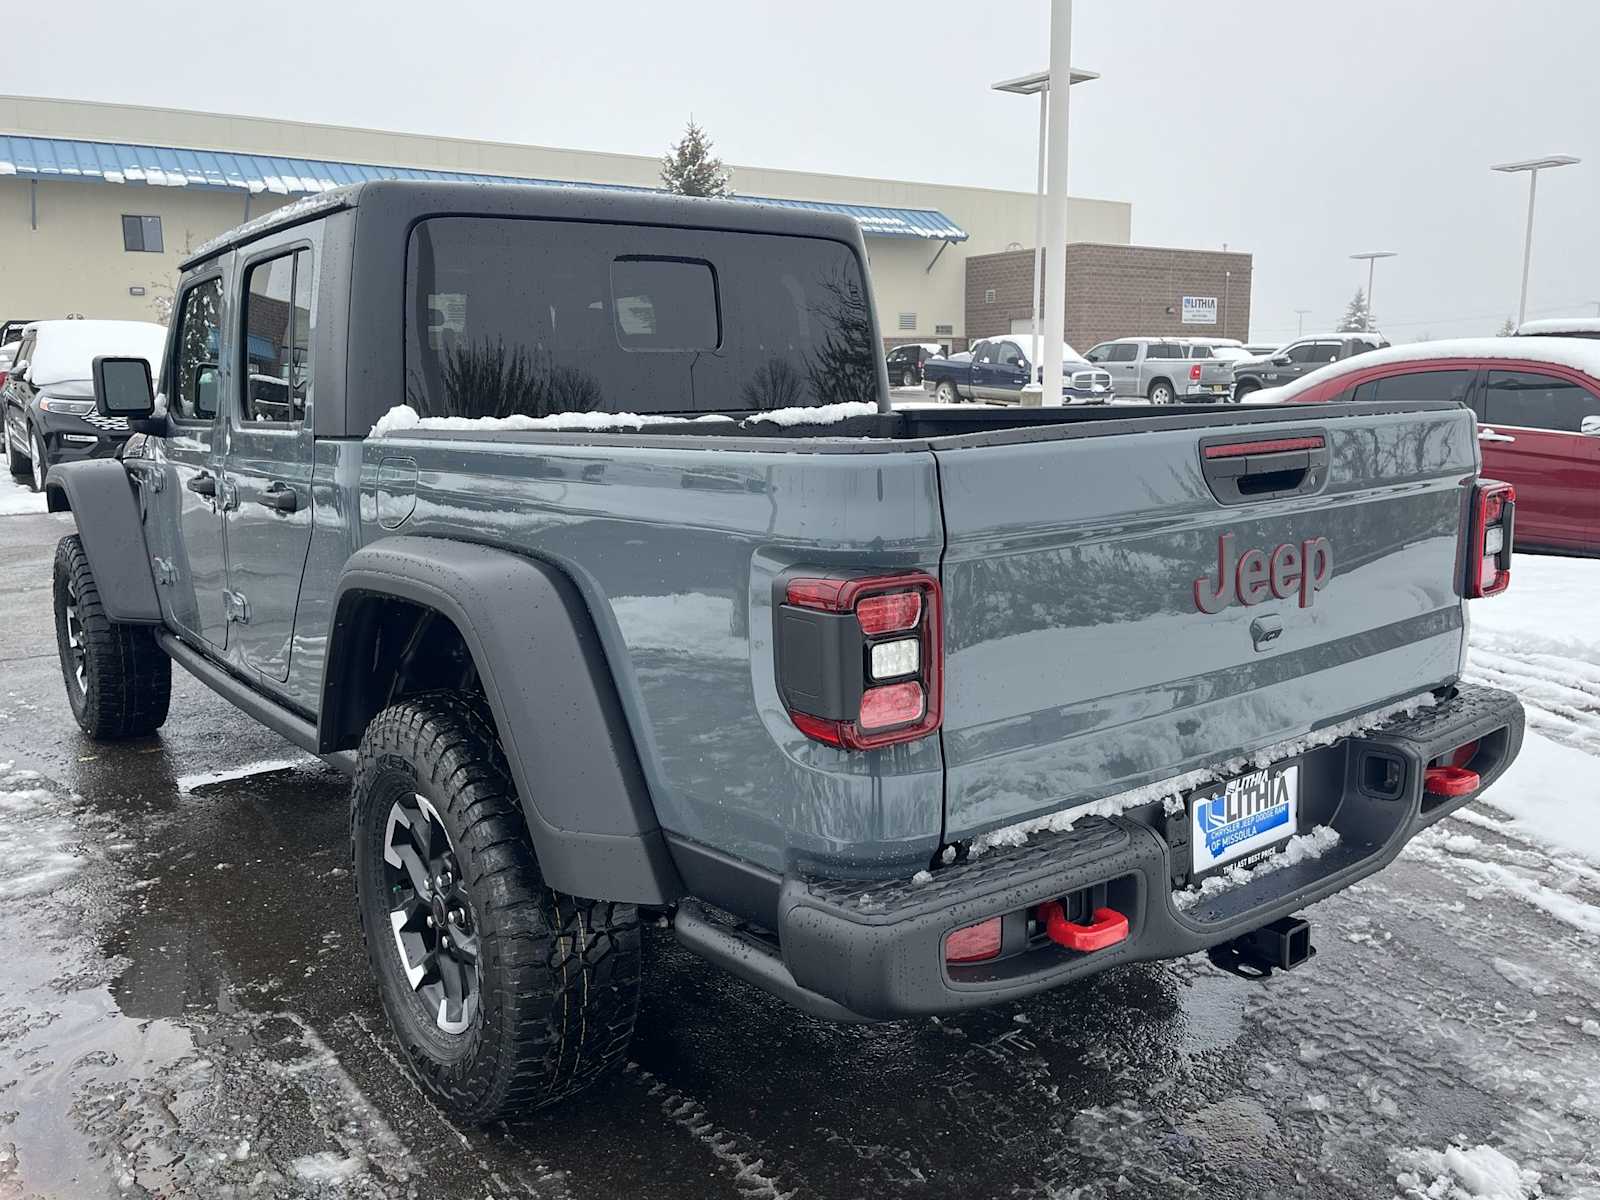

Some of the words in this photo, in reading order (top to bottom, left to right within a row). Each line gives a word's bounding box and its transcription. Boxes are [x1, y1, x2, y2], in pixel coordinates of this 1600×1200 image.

[1191, 298, 1215, 309] LITHIA
[1194, 531, 1334, 614] Jeep
[1236, 769, 1269, 791] LITHIA
[1227, 776, 1289, 823] LITHIA
[1211, 821, 1241, 839] CHRYSLER
[1241, 817, 1255, 829] JEEP
[1256, 810, 1274, 823] DODGE
[1274, 805, 1286, 815] RAM
[1211, 839, 1222, 851] OF
[1222, 825, 1257, 847] MISSOULA
[1222, 863, 1234, 874] THE
[1234, 857, 1248, 870] LAST
[1247, 852, 1261, 865] BEST
[1261, 846, 1277, 859] PRICE
